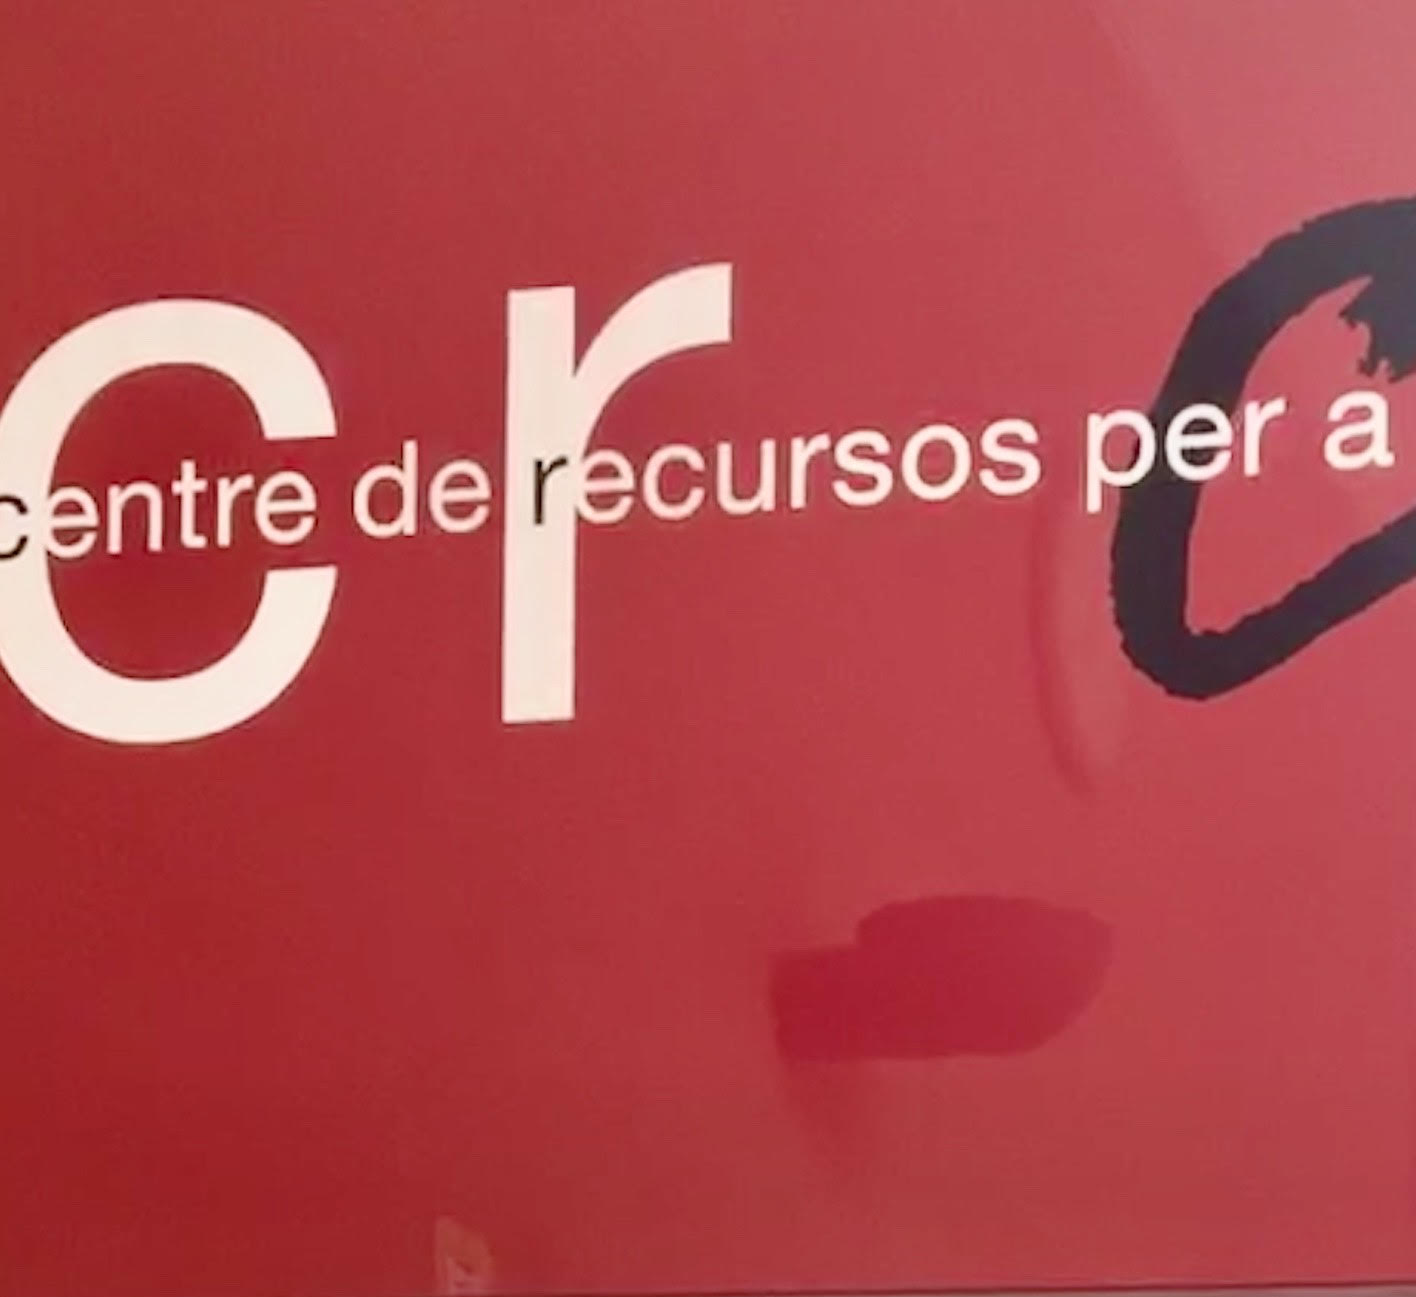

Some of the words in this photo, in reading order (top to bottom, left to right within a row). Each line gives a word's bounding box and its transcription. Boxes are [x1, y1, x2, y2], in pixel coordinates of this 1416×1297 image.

[353, 440, 491, 537] de
[533, 417, 1042, 526] recursos
[1085, 396, 1287, 513] per
[1323, 388, 1394, 471] a
